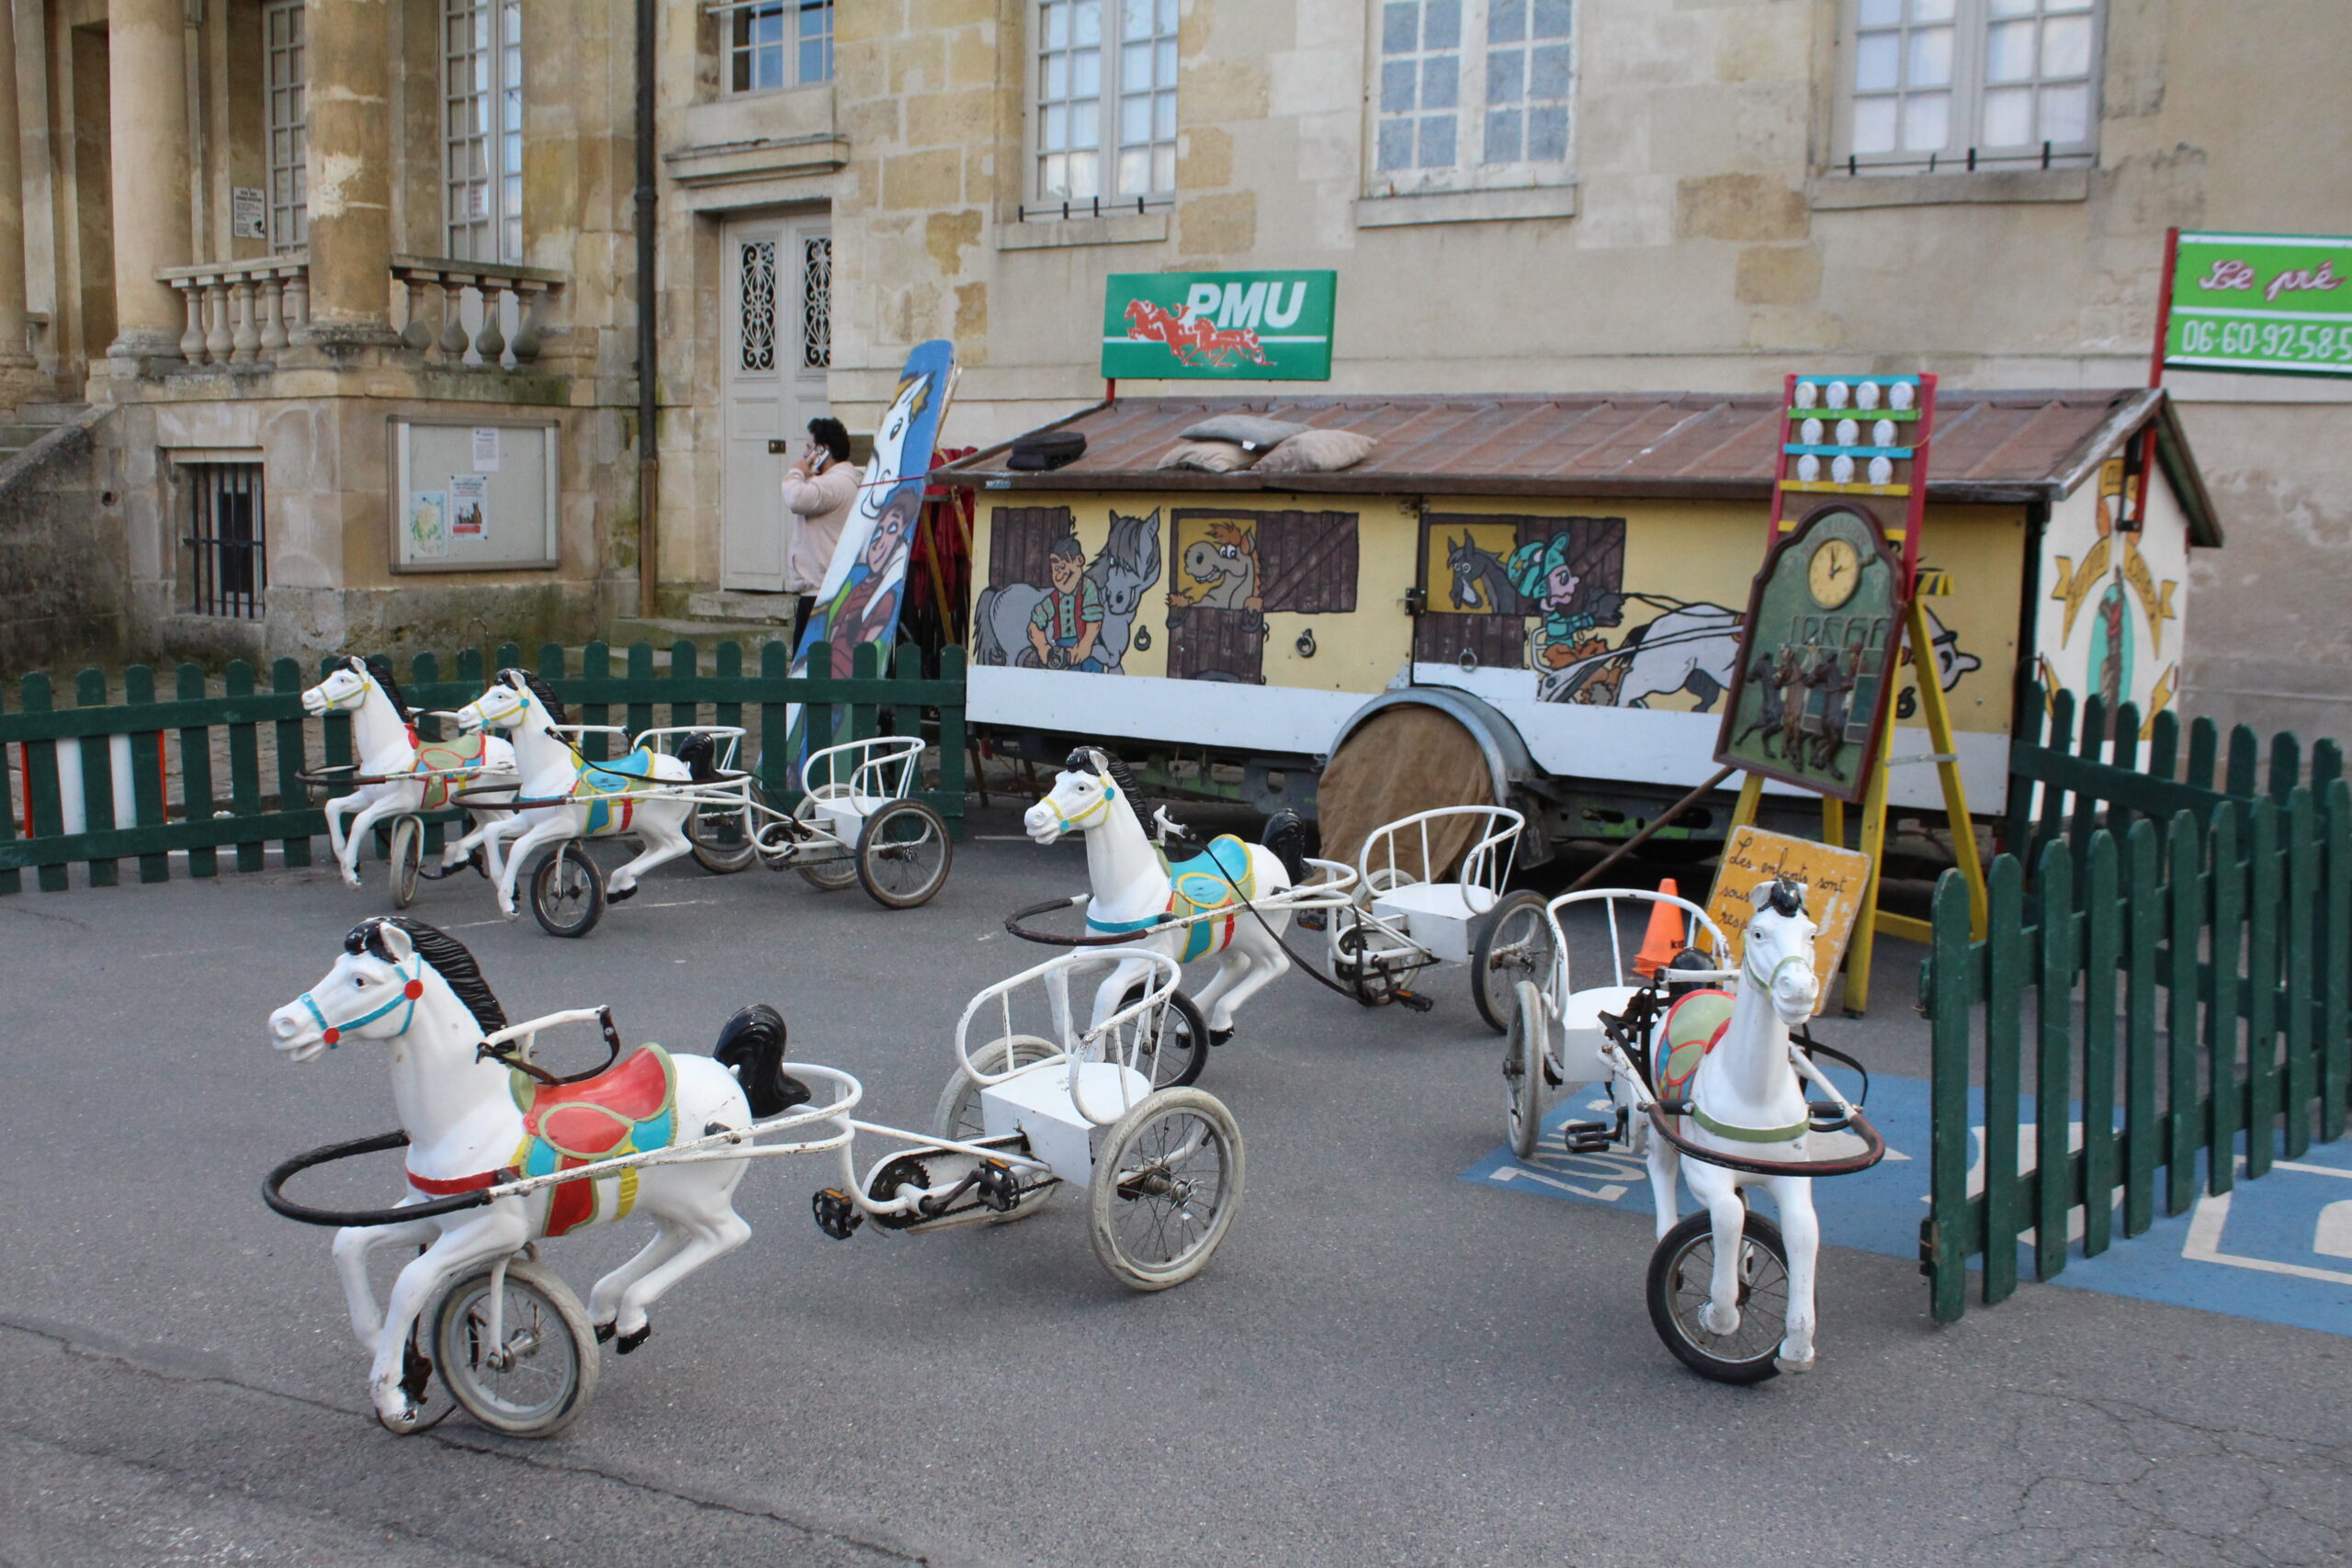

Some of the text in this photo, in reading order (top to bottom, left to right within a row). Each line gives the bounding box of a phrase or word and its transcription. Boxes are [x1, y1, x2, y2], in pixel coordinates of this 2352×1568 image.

[2199, 259, 2347, 302] Le pré
[1180, 281, 1307, 328] PMU
[1729, 837, 1752, 869] Les
[1815, 876, 1848, 893] sont
